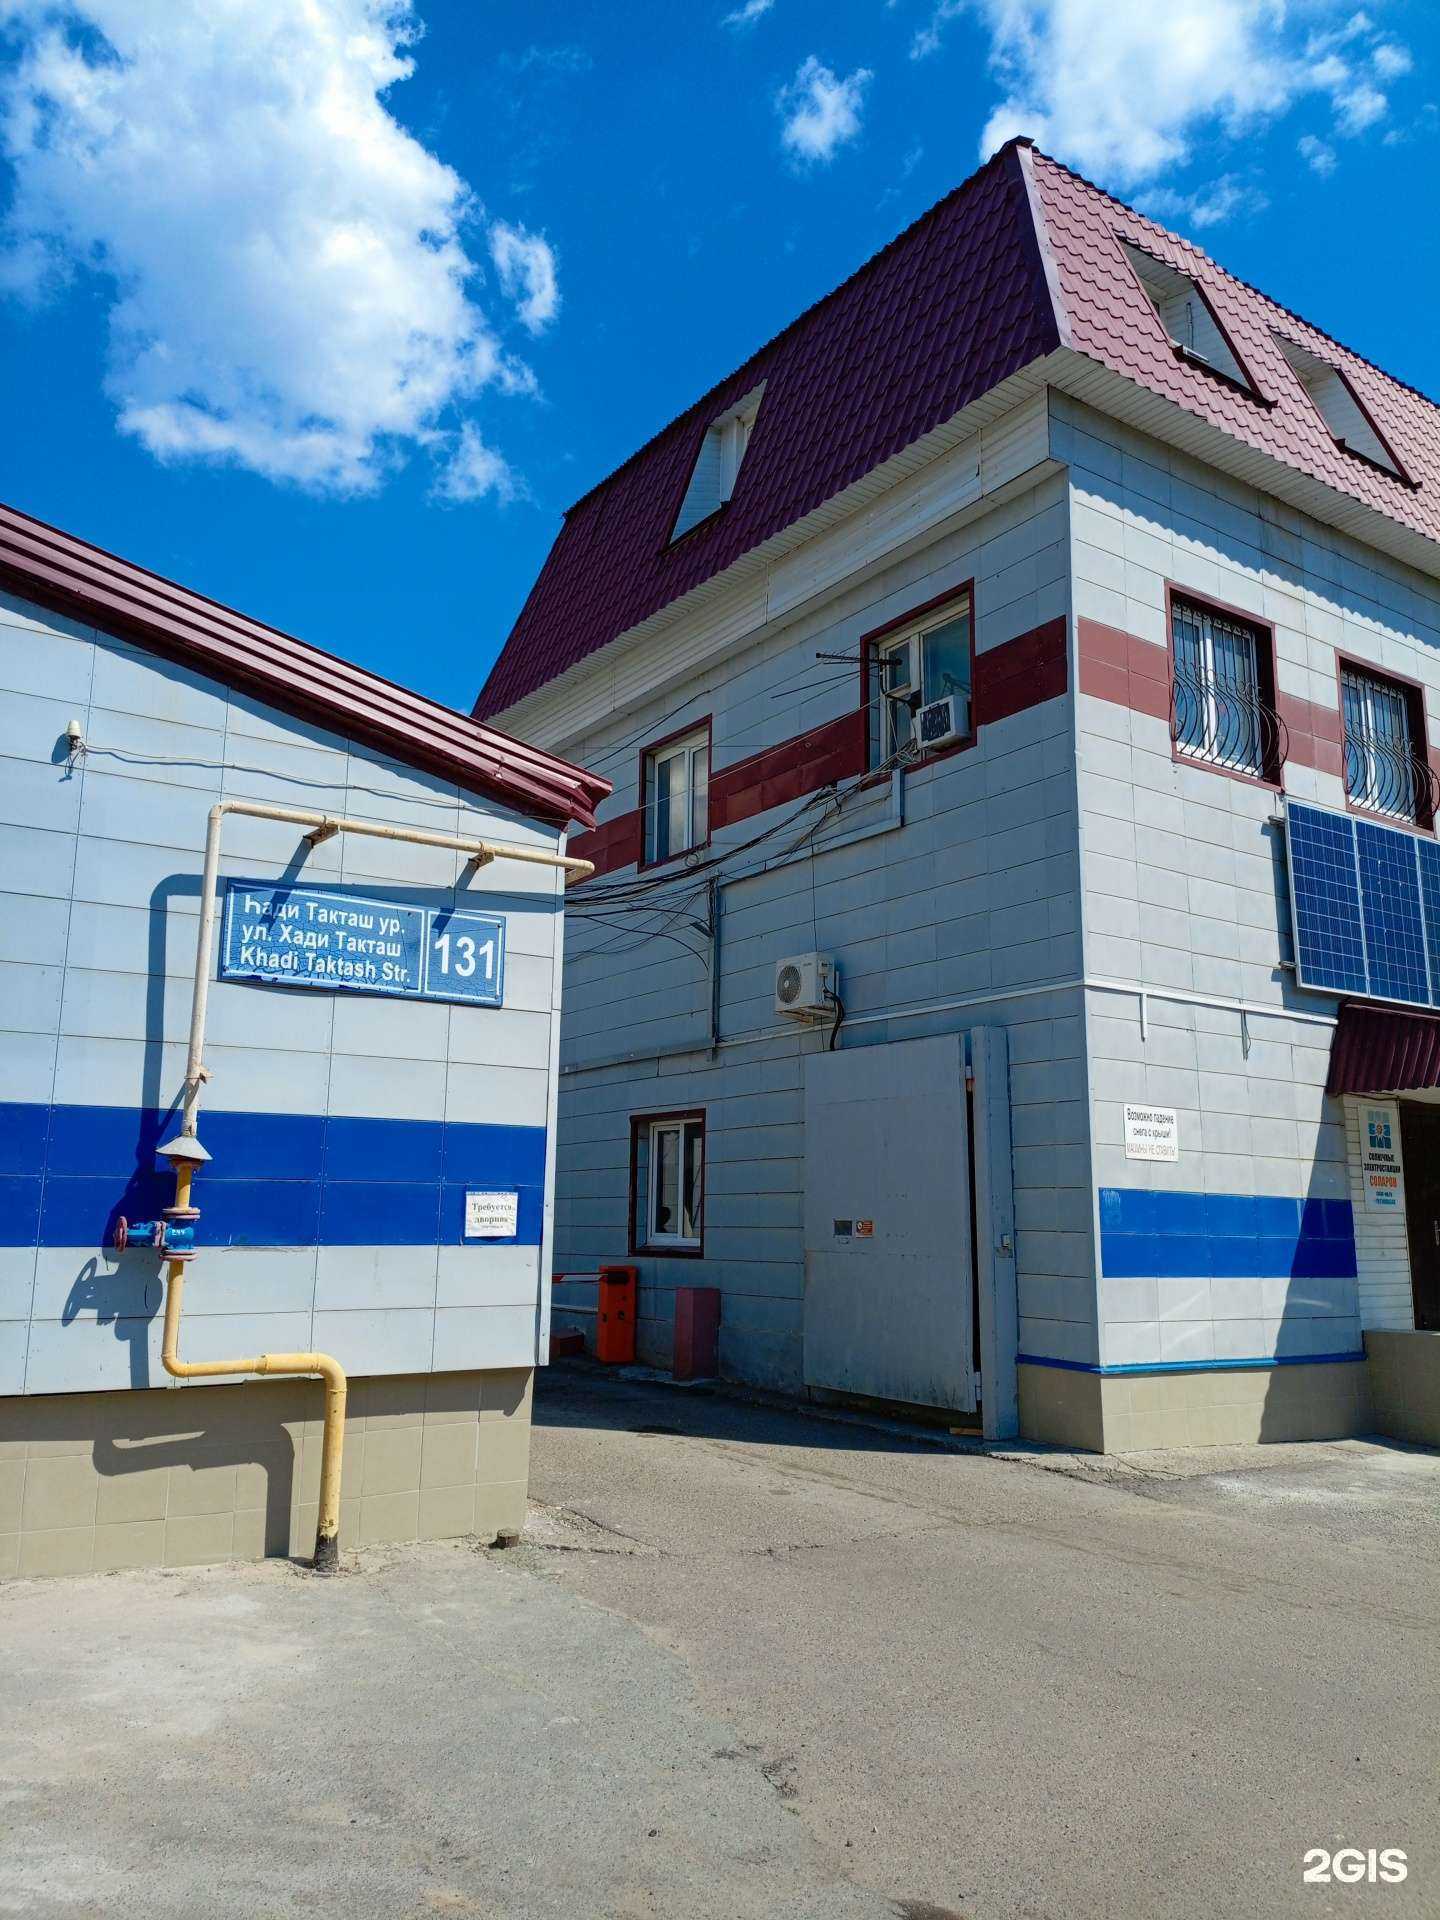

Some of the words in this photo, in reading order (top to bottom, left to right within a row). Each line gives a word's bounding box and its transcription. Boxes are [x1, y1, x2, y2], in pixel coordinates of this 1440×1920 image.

[305, 902, 374, 929] Такташ
[379, 916, 405, 936] ур.
[241, 924, 272, 944] ул.
[279, 923, 329, 949] Хади
[335, 931, 401, 957] Такташ
[434, 933, 494, 979] 131
[240, 945, 299, 970] Khadi
[305, 952, 377, 979] Taktash
[381, 961, 411, 983] Str.
[471, 1202, 513, 1213] Требуется
